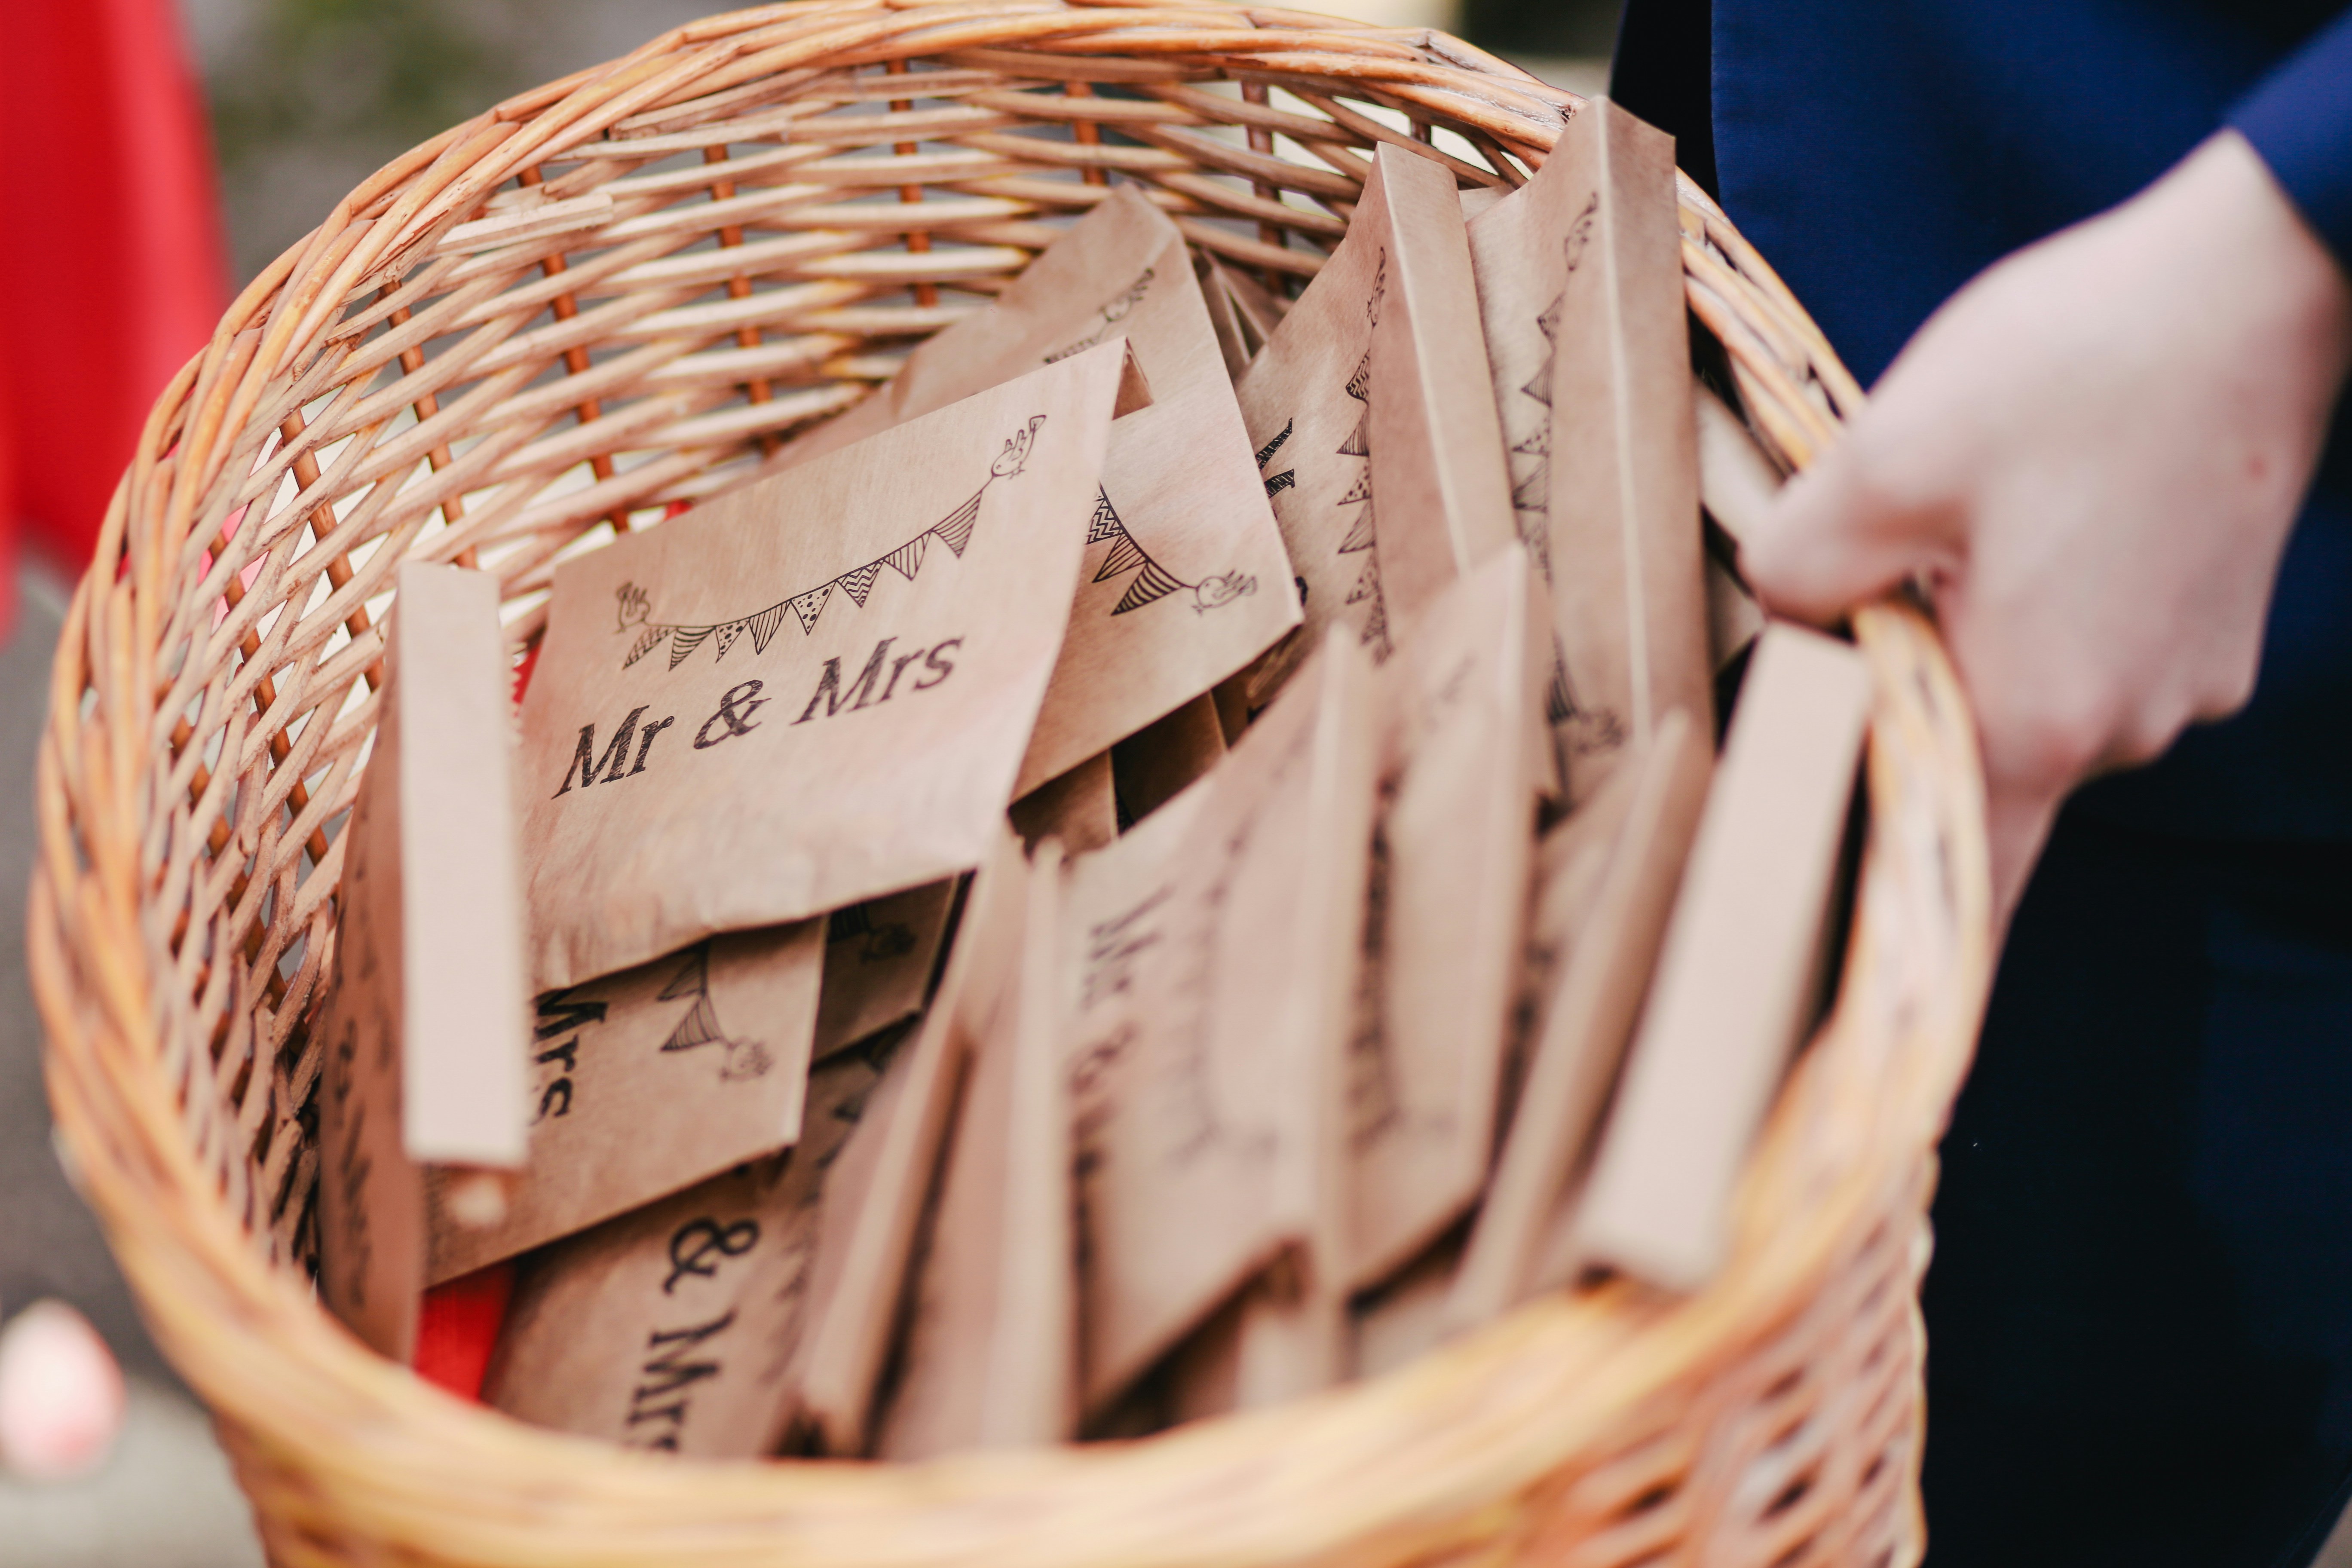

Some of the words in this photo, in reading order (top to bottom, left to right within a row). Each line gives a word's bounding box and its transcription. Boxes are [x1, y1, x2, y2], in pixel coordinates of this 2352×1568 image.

[551, 704, 675, 800] Mr
[693, 679, 772, 750] &
[789, 634, 965, 726] Mrs
[662, 1216, 761, 1295] &
